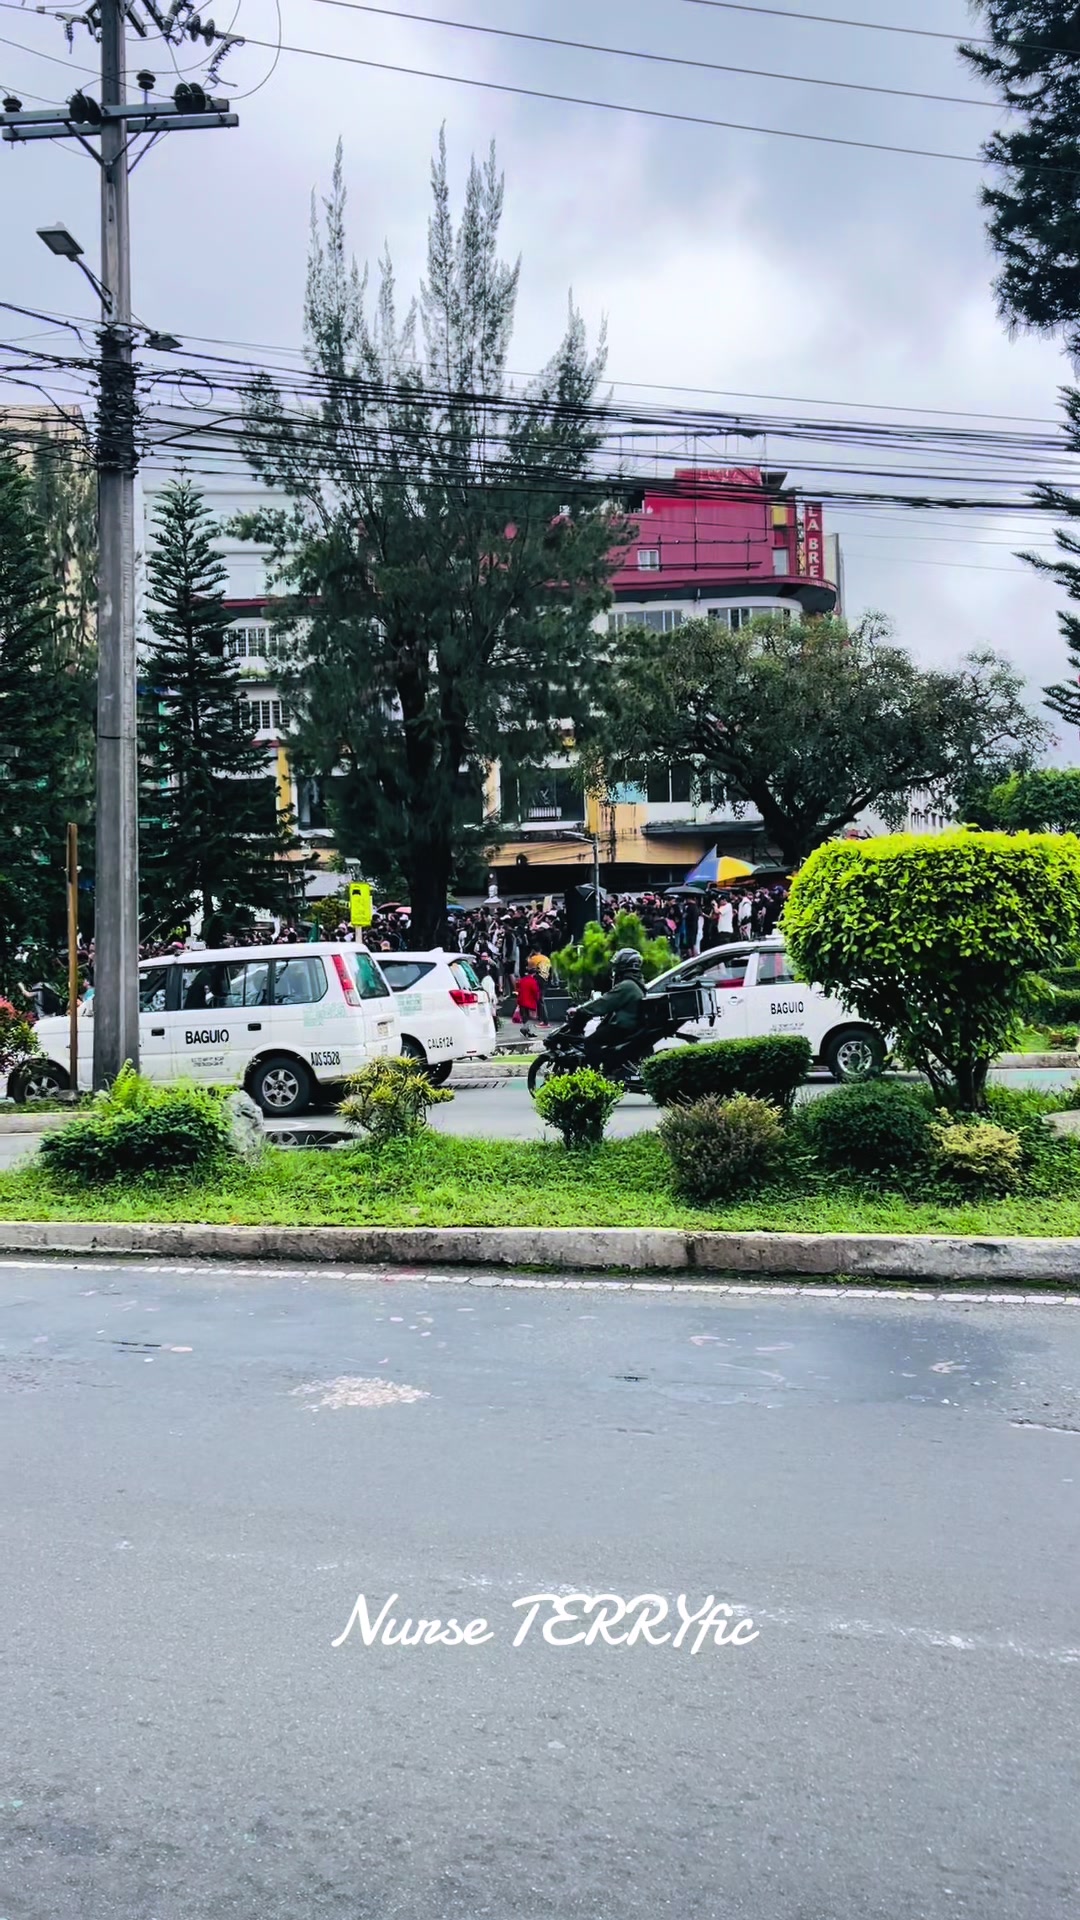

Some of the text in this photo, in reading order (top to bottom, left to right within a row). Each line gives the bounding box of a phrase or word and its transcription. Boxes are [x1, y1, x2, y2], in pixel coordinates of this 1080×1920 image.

[807, 505, 820, 531] LA
[771, 1001, 804, 1015] BAGUIO
[185, 1029, 230, 1045] BAGUIO
[323, 1051, 341, 1066] 5528
